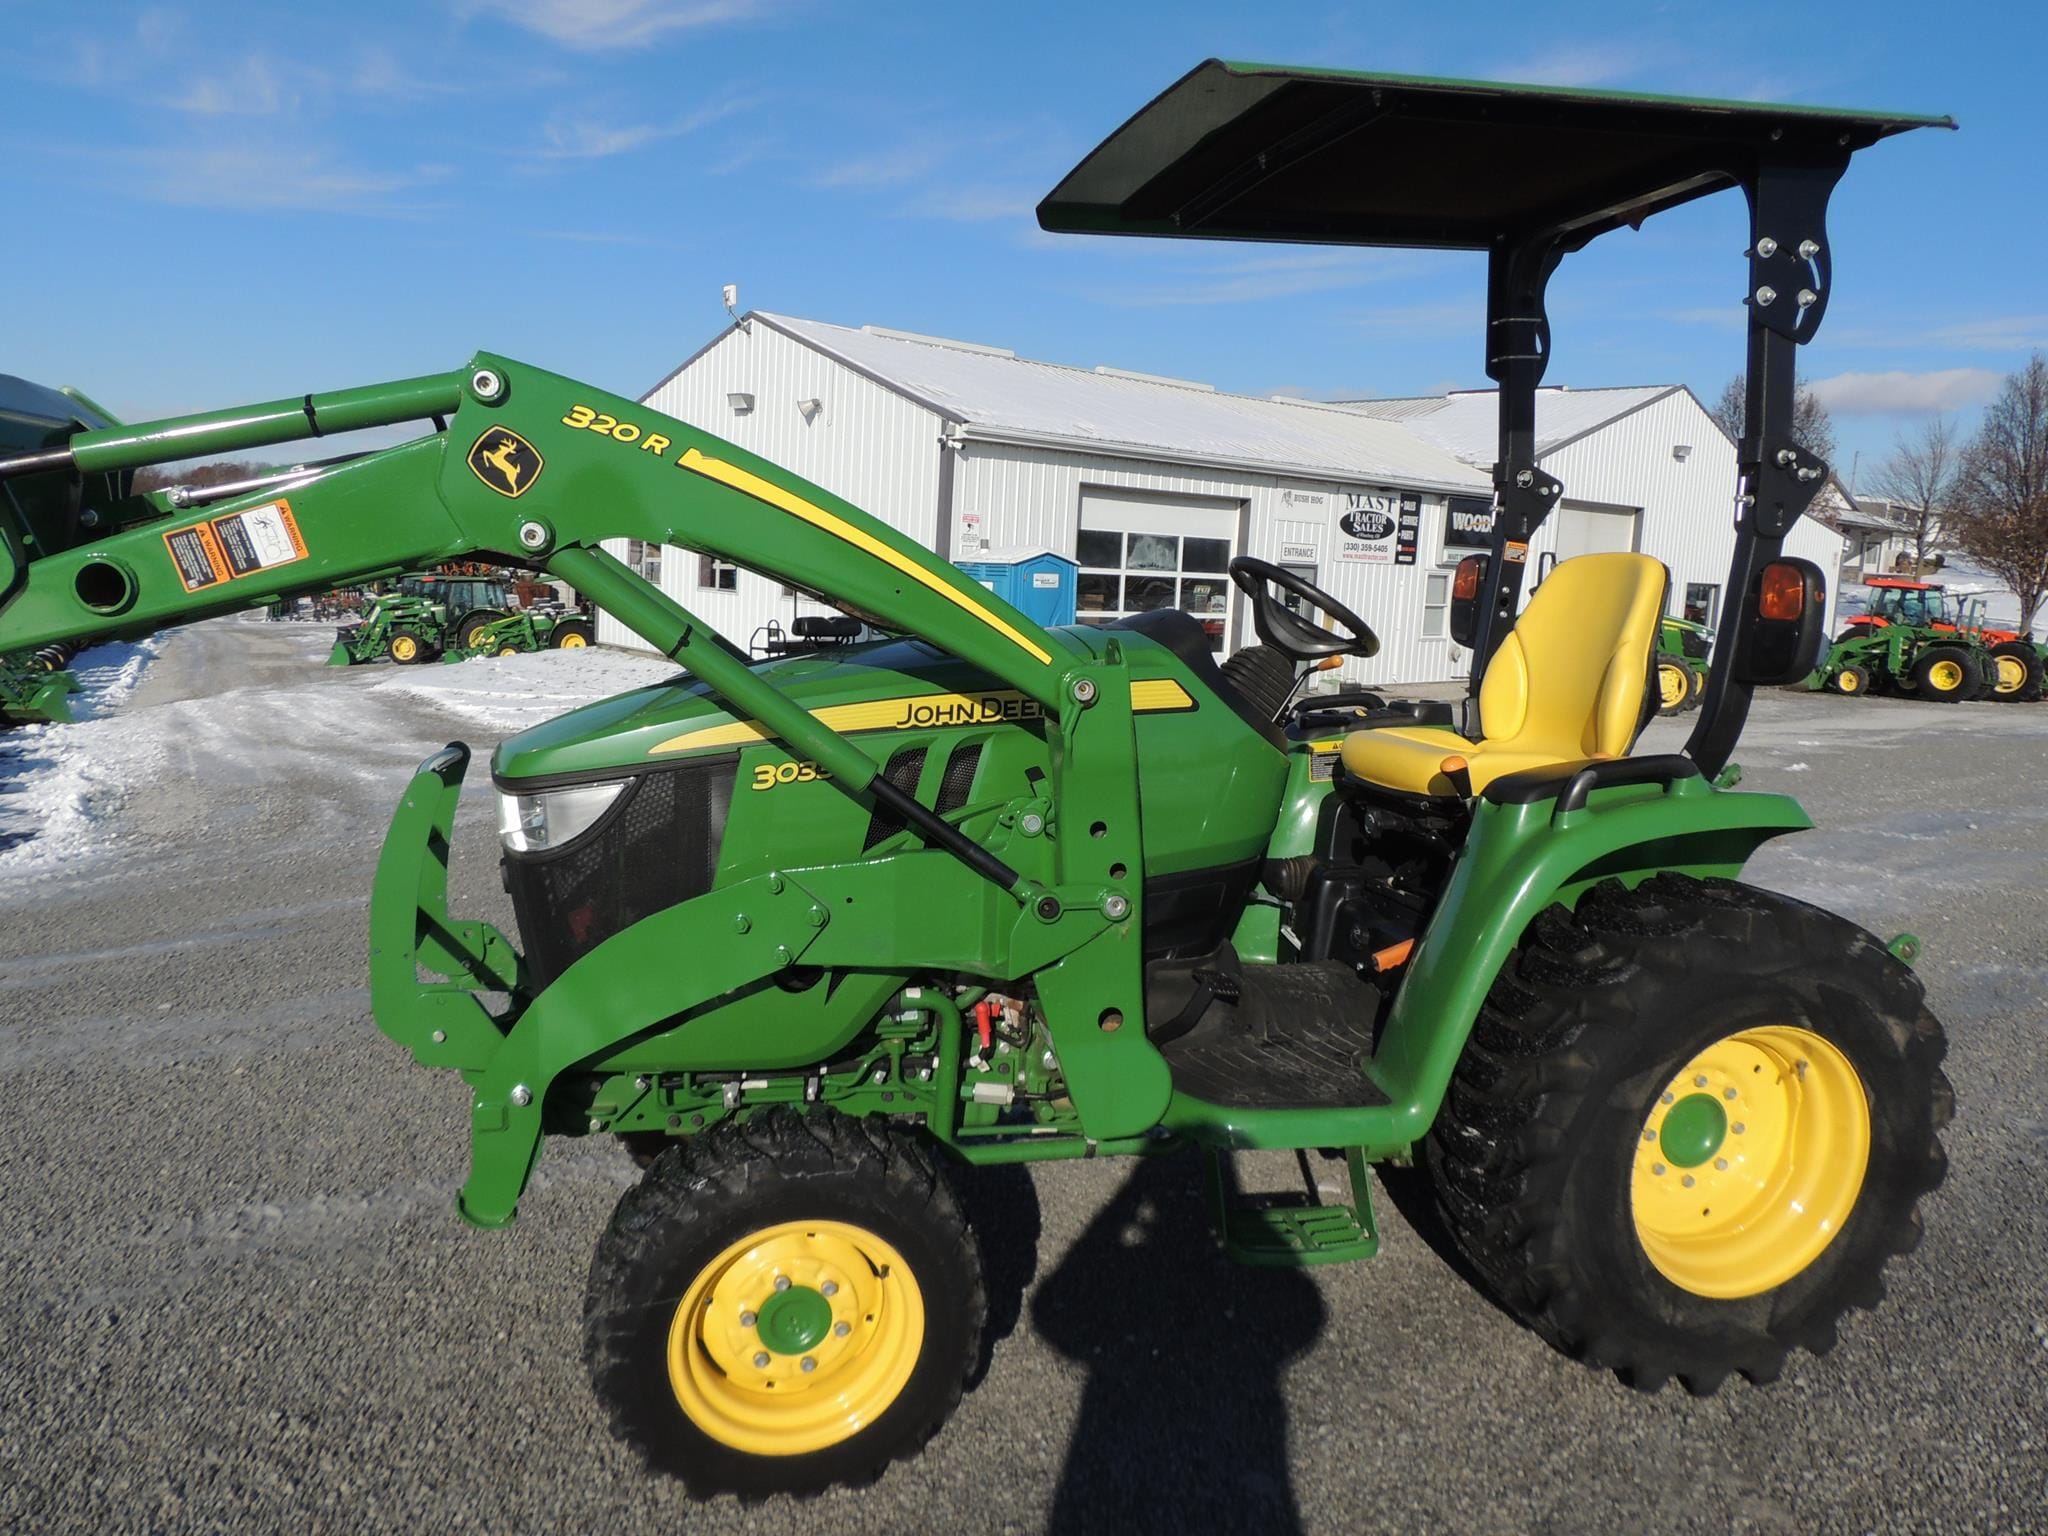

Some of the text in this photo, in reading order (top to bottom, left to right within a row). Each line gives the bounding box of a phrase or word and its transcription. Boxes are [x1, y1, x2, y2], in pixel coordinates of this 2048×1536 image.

[560, 403, 672, 457] 320 R
[1346, 492, 1396, 513] MAST
[1349, 511, 1387, 525] TRACTOR
[1352, 521, 1384, 533] SALES
[1452, 511, 1492, 533] WOOD
[283, 515, 304, 551] WARNING
[1283, 547, 1314, 558] ENTRANCE
[1343, 542, 1360, 552] (330)
[204, 539, 224, 577] WARNING
[896, 703, 975, 729] JOHN
